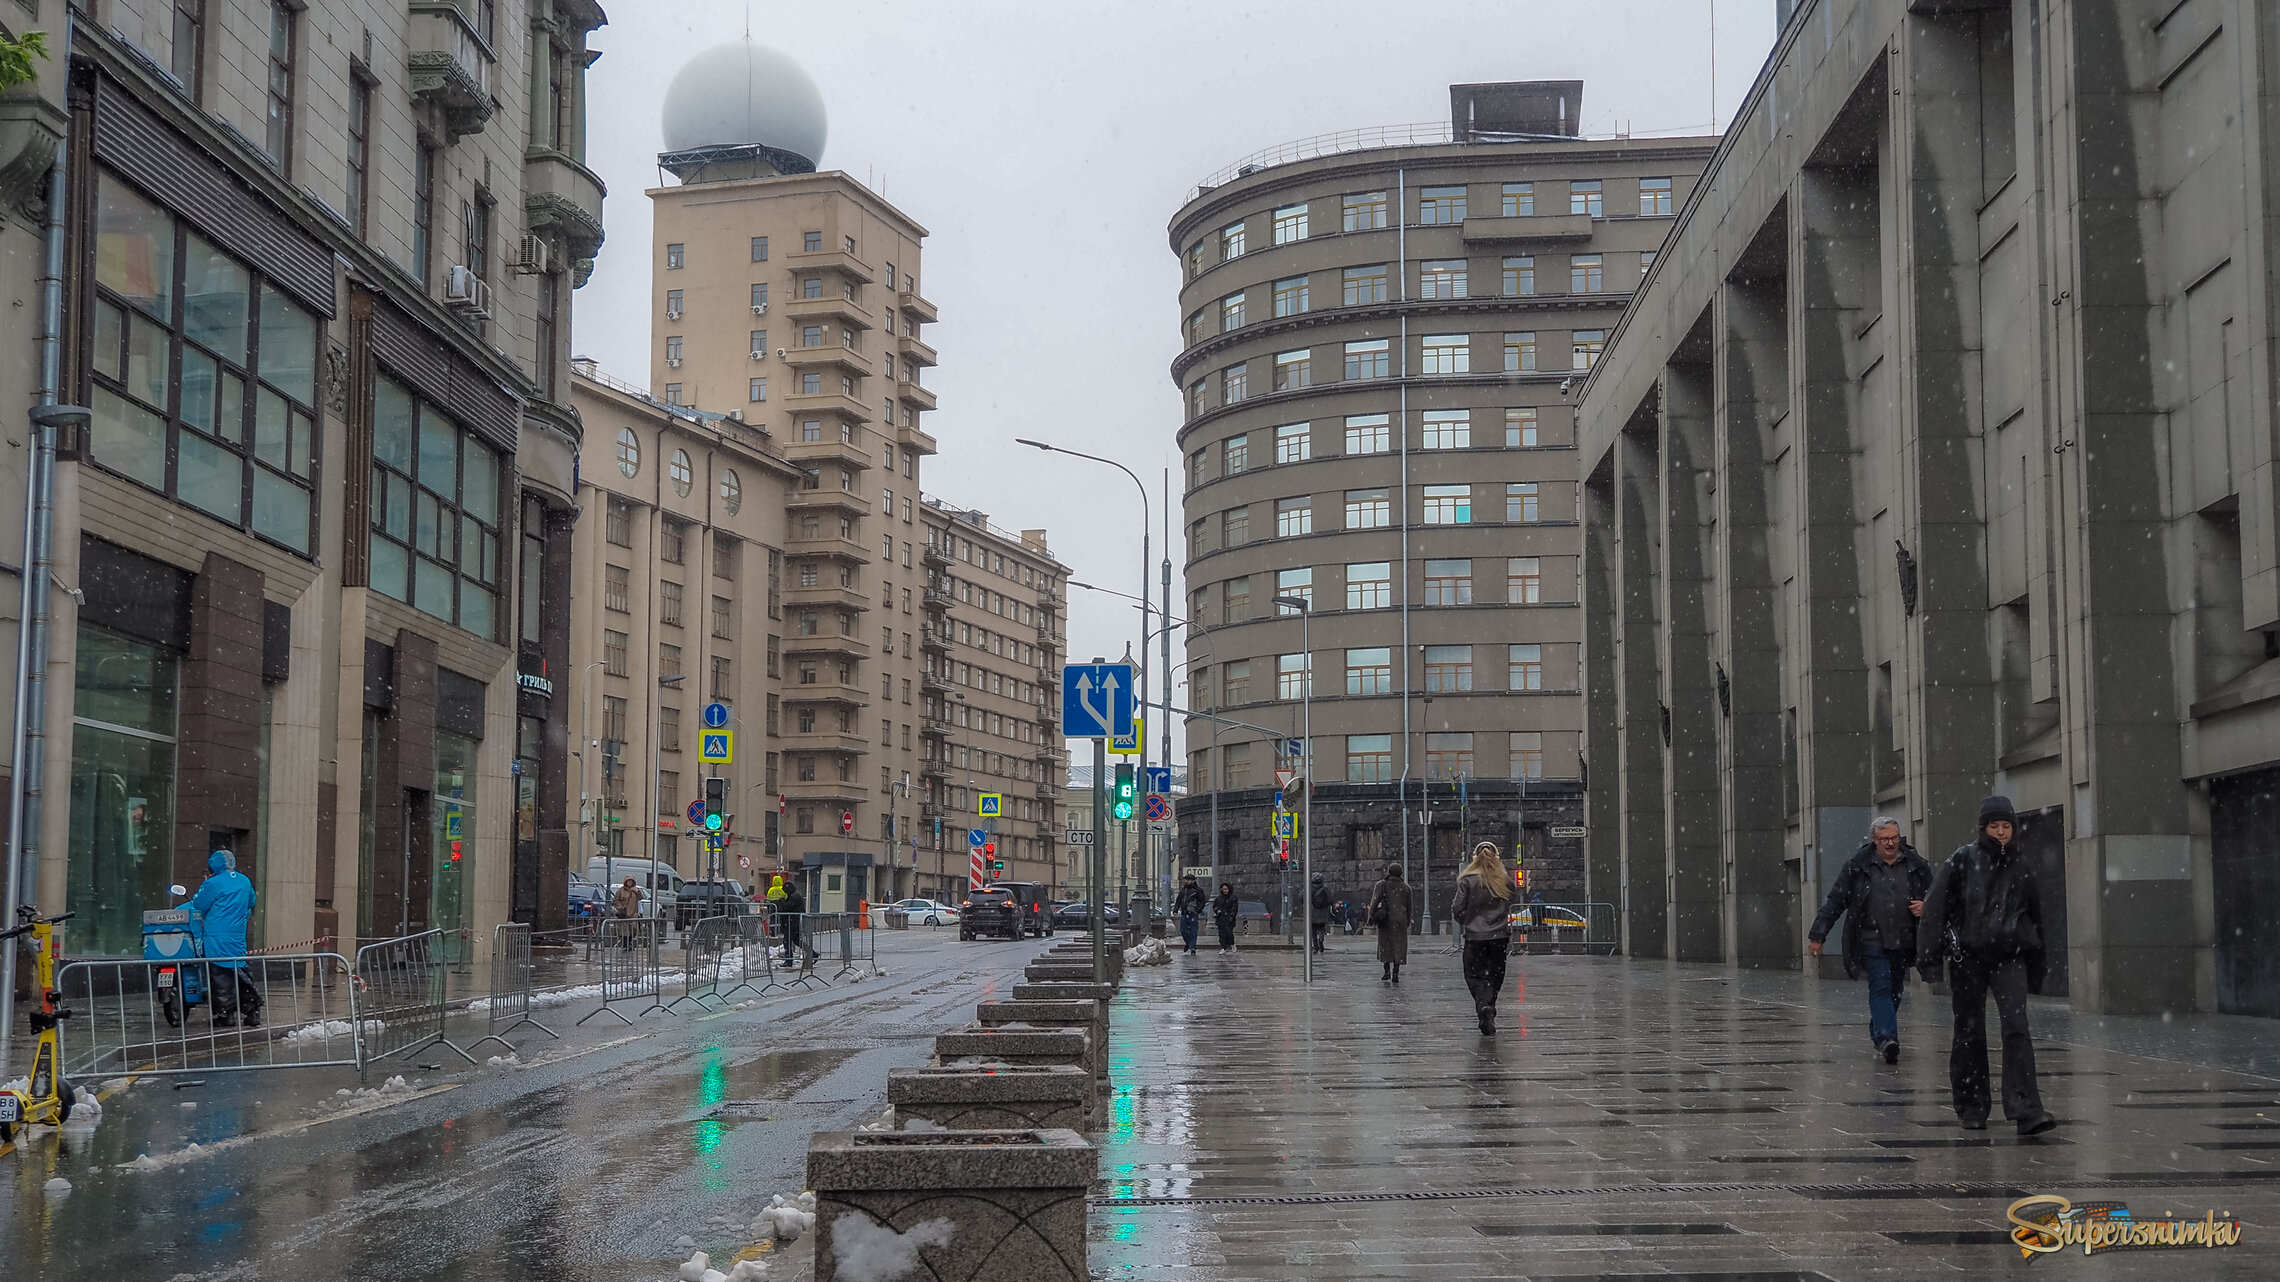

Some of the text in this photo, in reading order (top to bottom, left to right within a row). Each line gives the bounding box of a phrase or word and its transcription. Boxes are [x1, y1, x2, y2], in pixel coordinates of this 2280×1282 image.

[523, 674, 547, 690] ГРИЛЬ
[1071, 832, 1093, 844] СТО
[1186, 868, 1209, 876] СТОП
